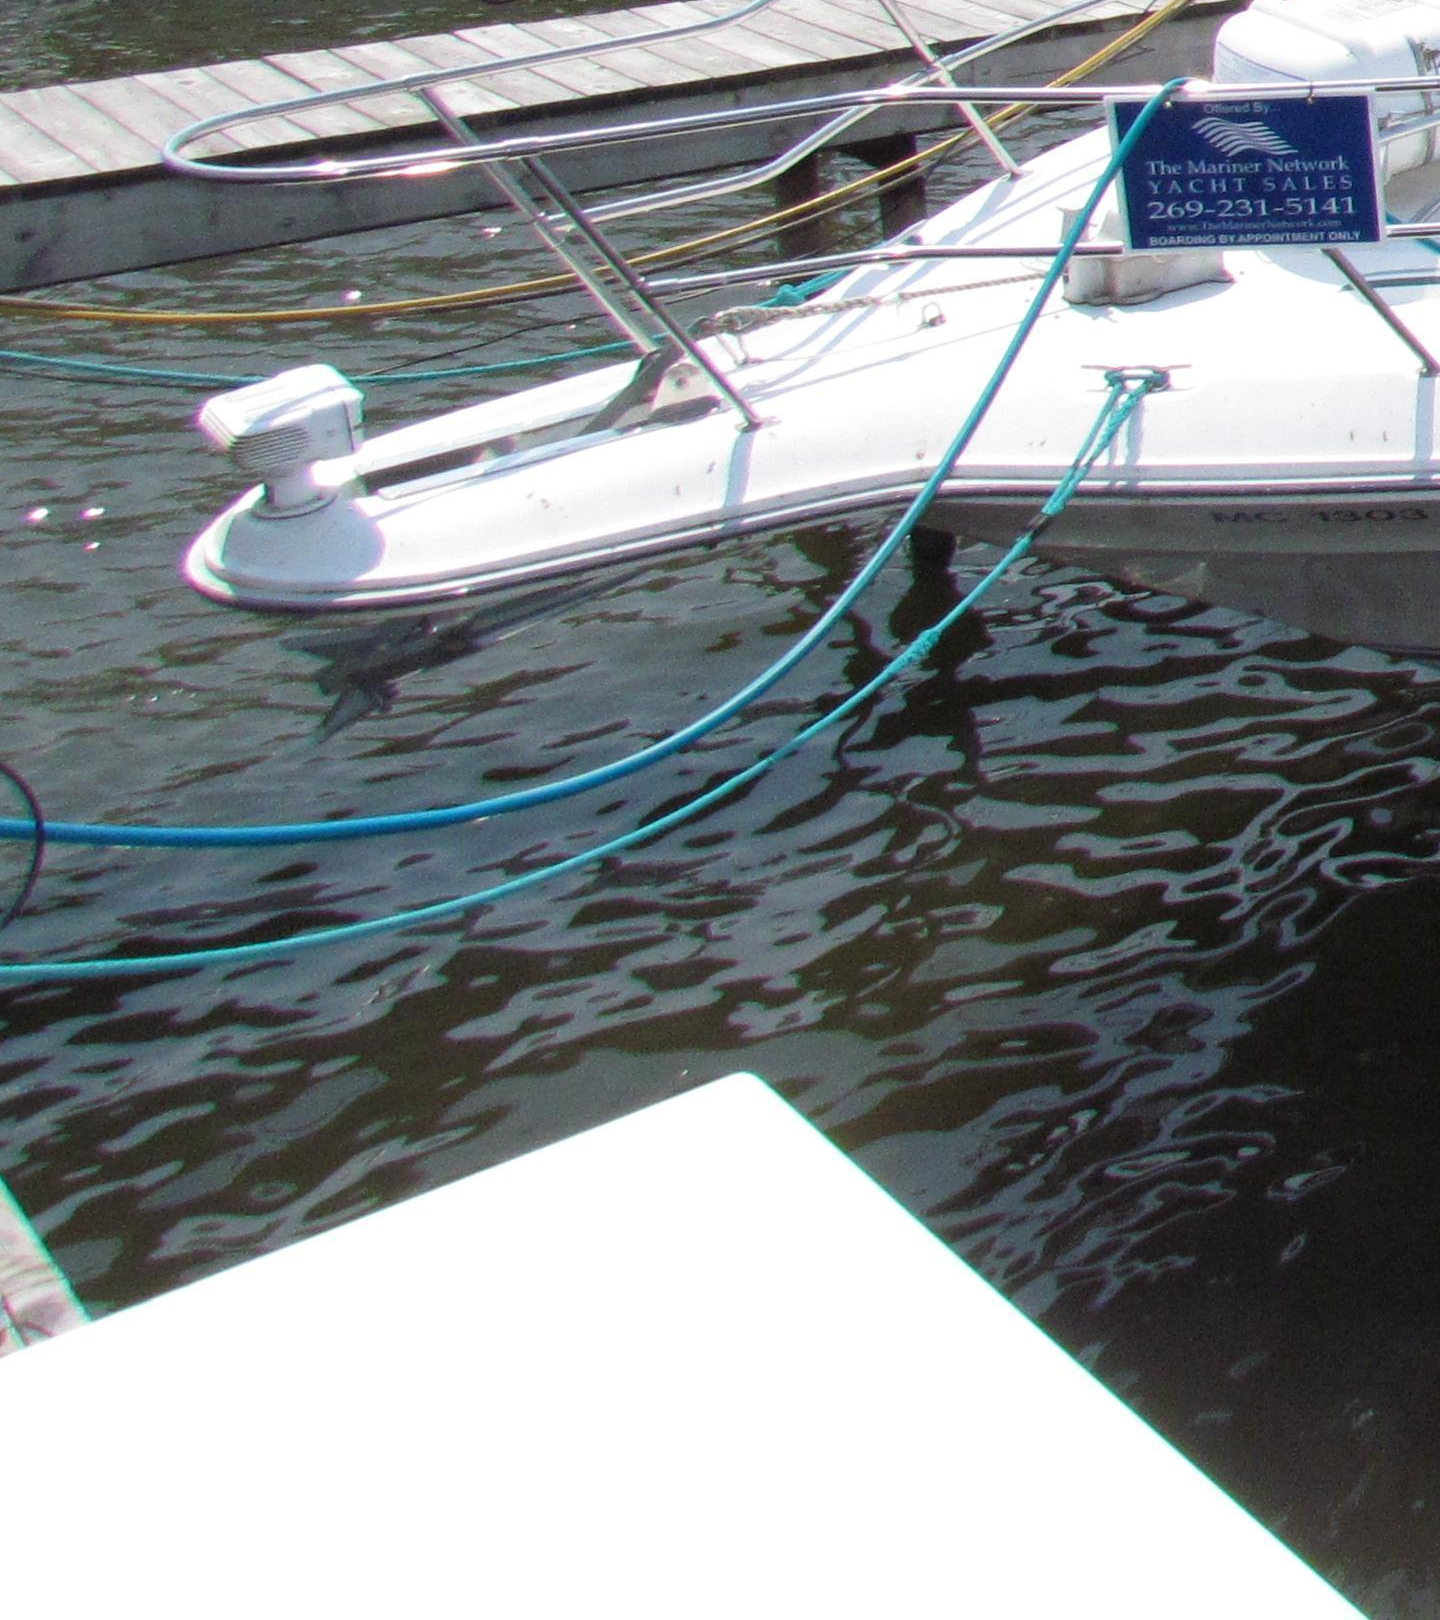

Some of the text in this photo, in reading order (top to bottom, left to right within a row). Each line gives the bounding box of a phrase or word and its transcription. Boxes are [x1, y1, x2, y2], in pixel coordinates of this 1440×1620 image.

[1203, 103, 1255, 114] Offered
[1147, 156, 1349, 175] The Mariner Network
[1149, 175, 1353, 195] YACHT SALES
[1148, 196, 1357, 219] 269-231-5141
[1150, 230, 1360, 246] BOARDING BY APPOINTMENT ONLY
